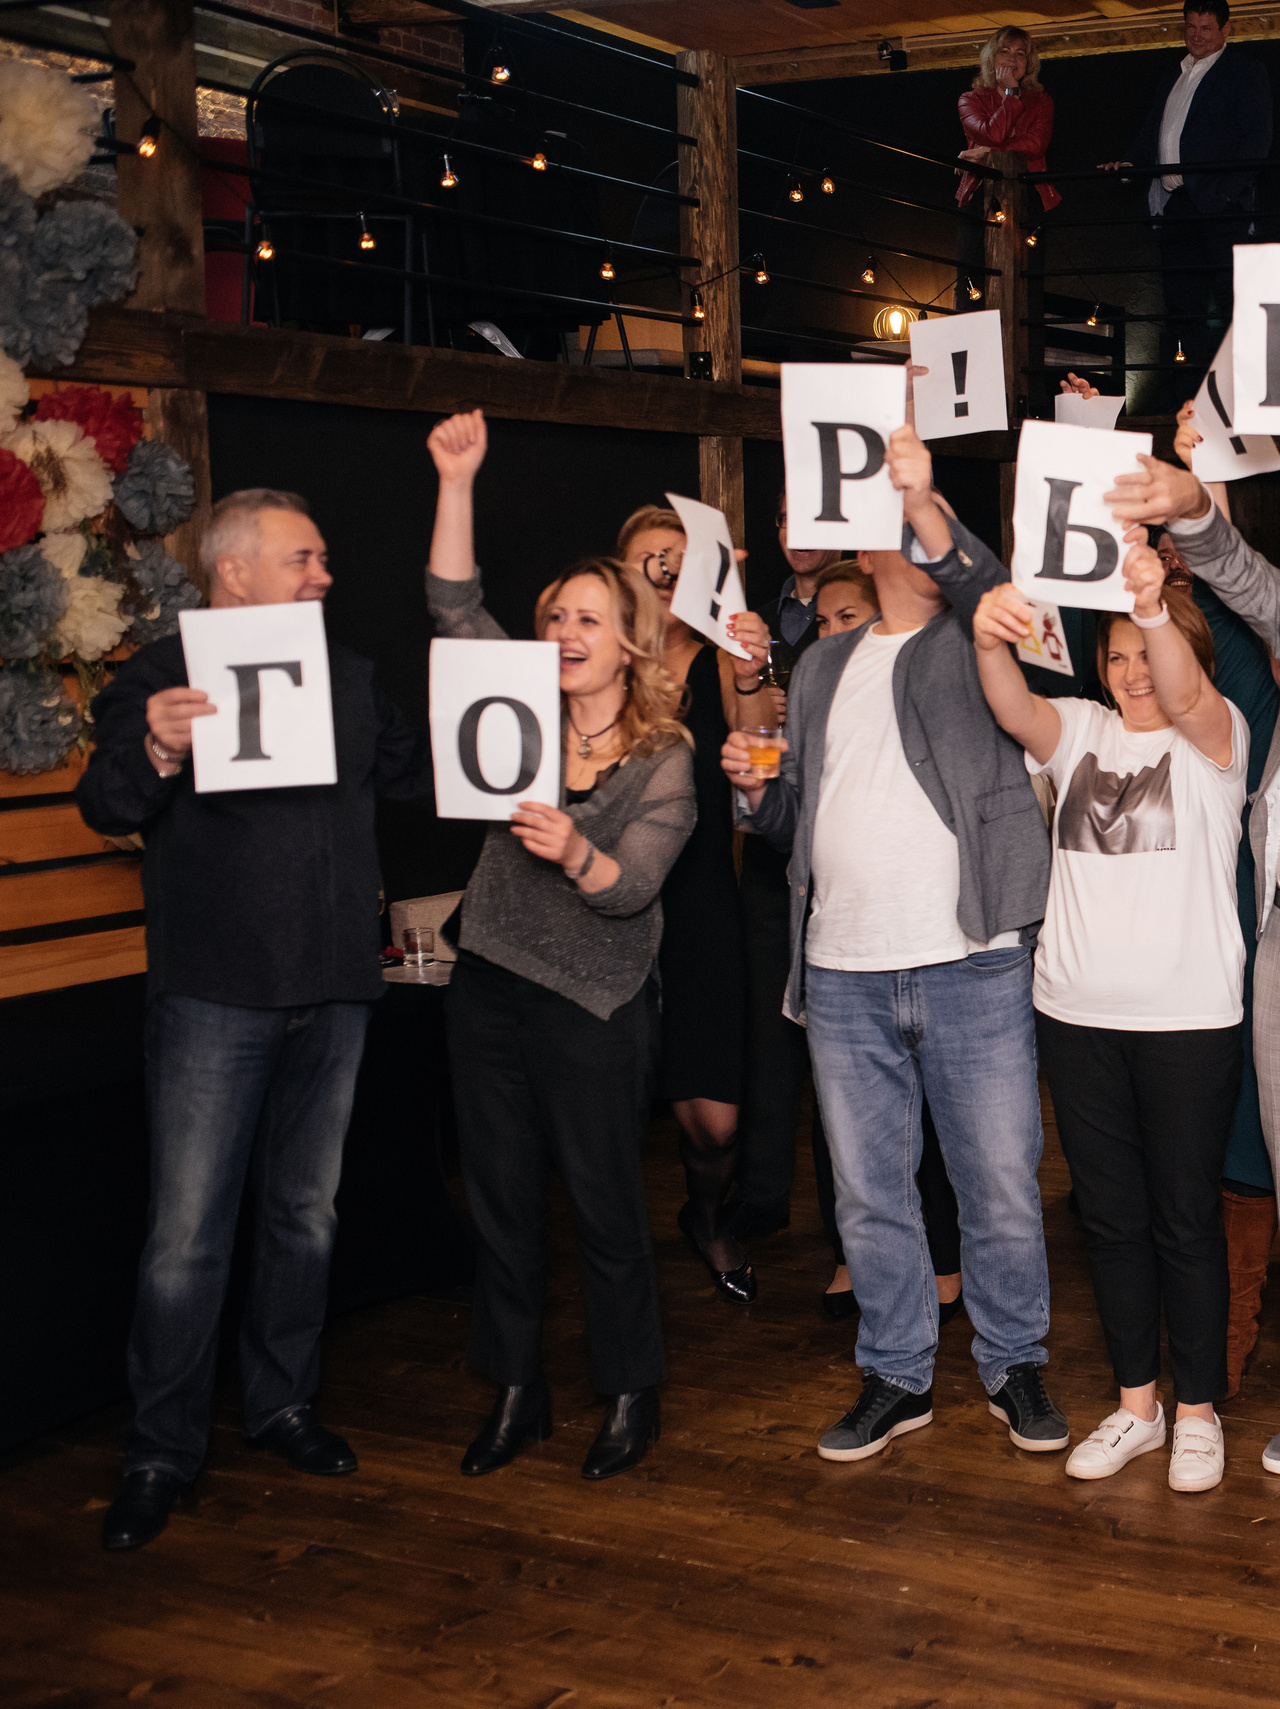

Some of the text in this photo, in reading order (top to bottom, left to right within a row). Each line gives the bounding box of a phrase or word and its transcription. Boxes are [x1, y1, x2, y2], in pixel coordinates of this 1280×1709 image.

[949, 349, 969, 418] !
[1207, 369, 1248, 456] !
[810, 421, 887, 523] Р
[1034, 477, 1119, 583] Ь
[709, 540, 731, 622] !
[227, 661, 303, 761] Г
[457, 696, 542, 796] О
